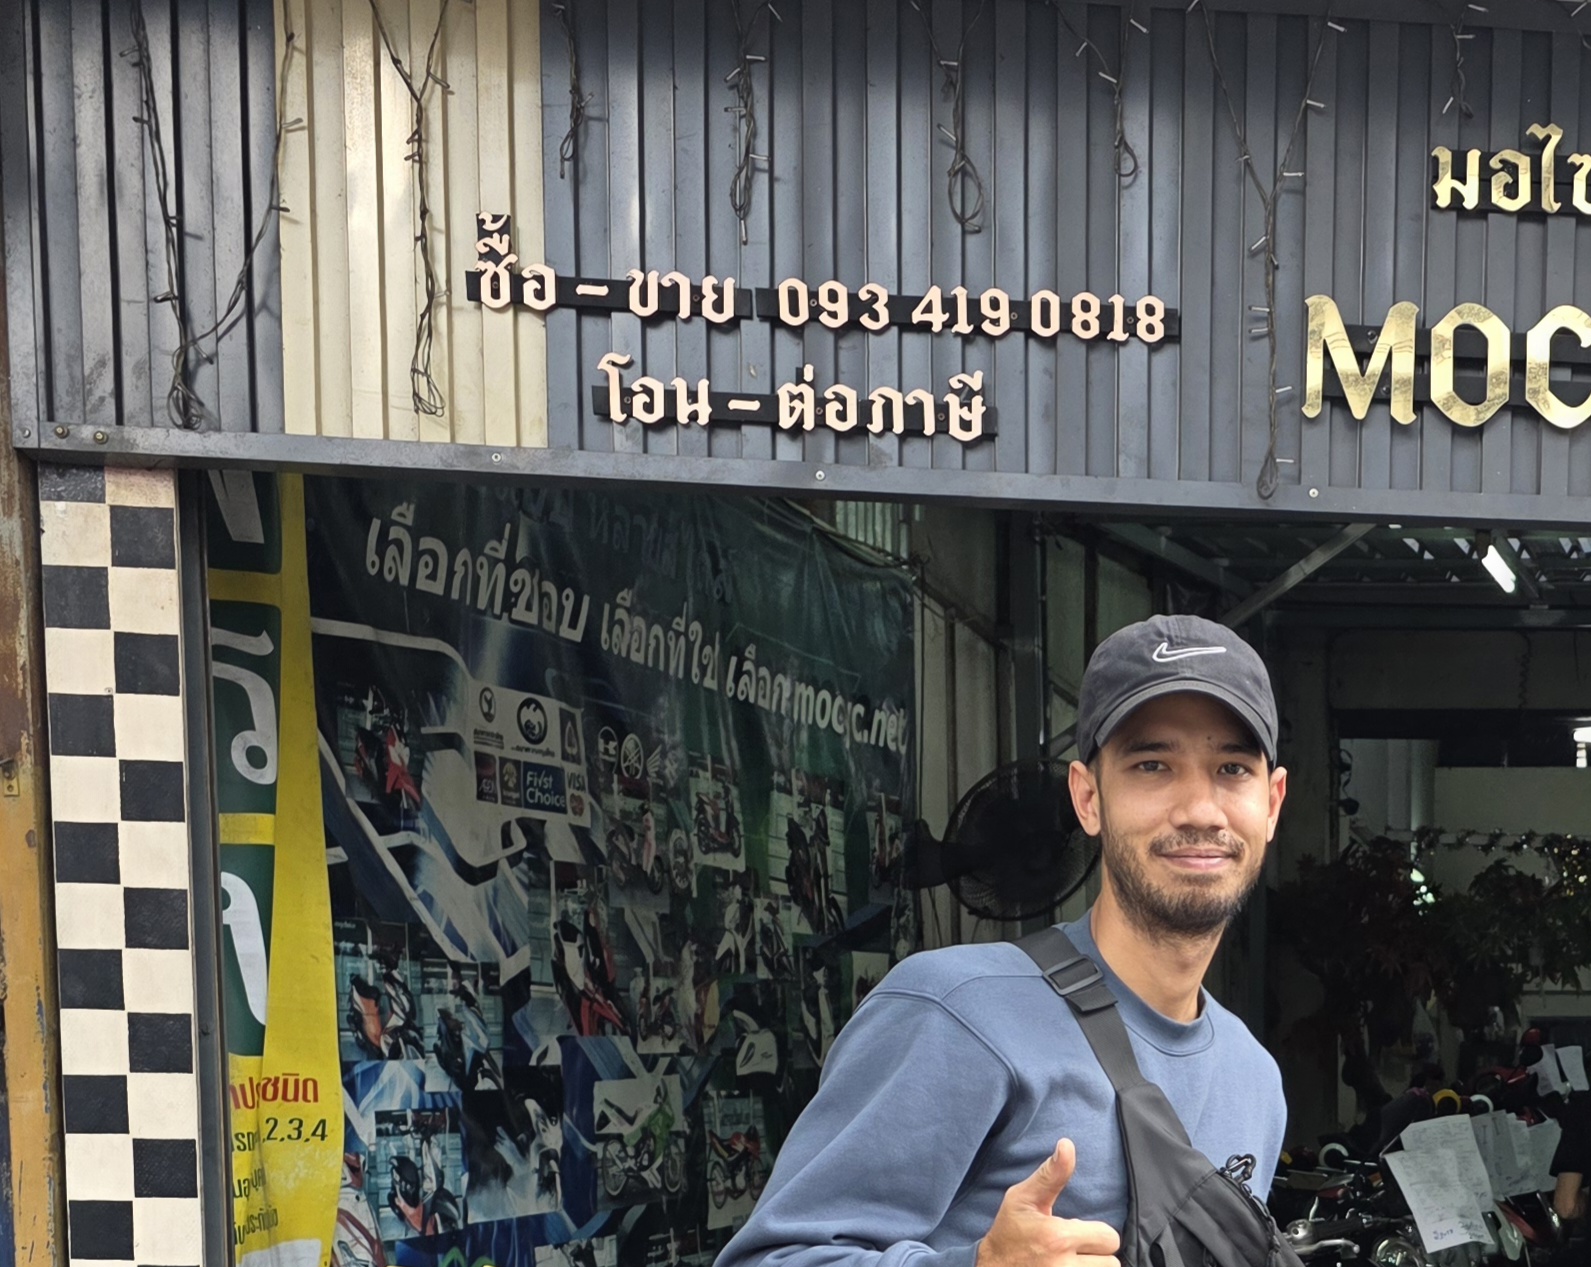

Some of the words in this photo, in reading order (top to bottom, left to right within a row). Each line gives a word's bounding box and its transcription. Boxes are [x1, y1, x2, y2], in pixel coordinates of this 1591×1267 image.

[475, 211, 557, 311] ซื้อ
[626, 268, 736, 323] ขาย
[778, 277, 890, 332] 093
[912, 285, 1010, 337] 419
[1029, 289, 1166, 344] 0818
[597, 353, 712, 428] โอน
[777, 364, 987, 442] ต่อภาษี
[365, 500, 591, 644] เลือกที่ชอบ
[601, 587, 720, 692] เลือกที่ใช่
[526, 770, 554, 788] First
[526, 788, 566, 808] Choice
